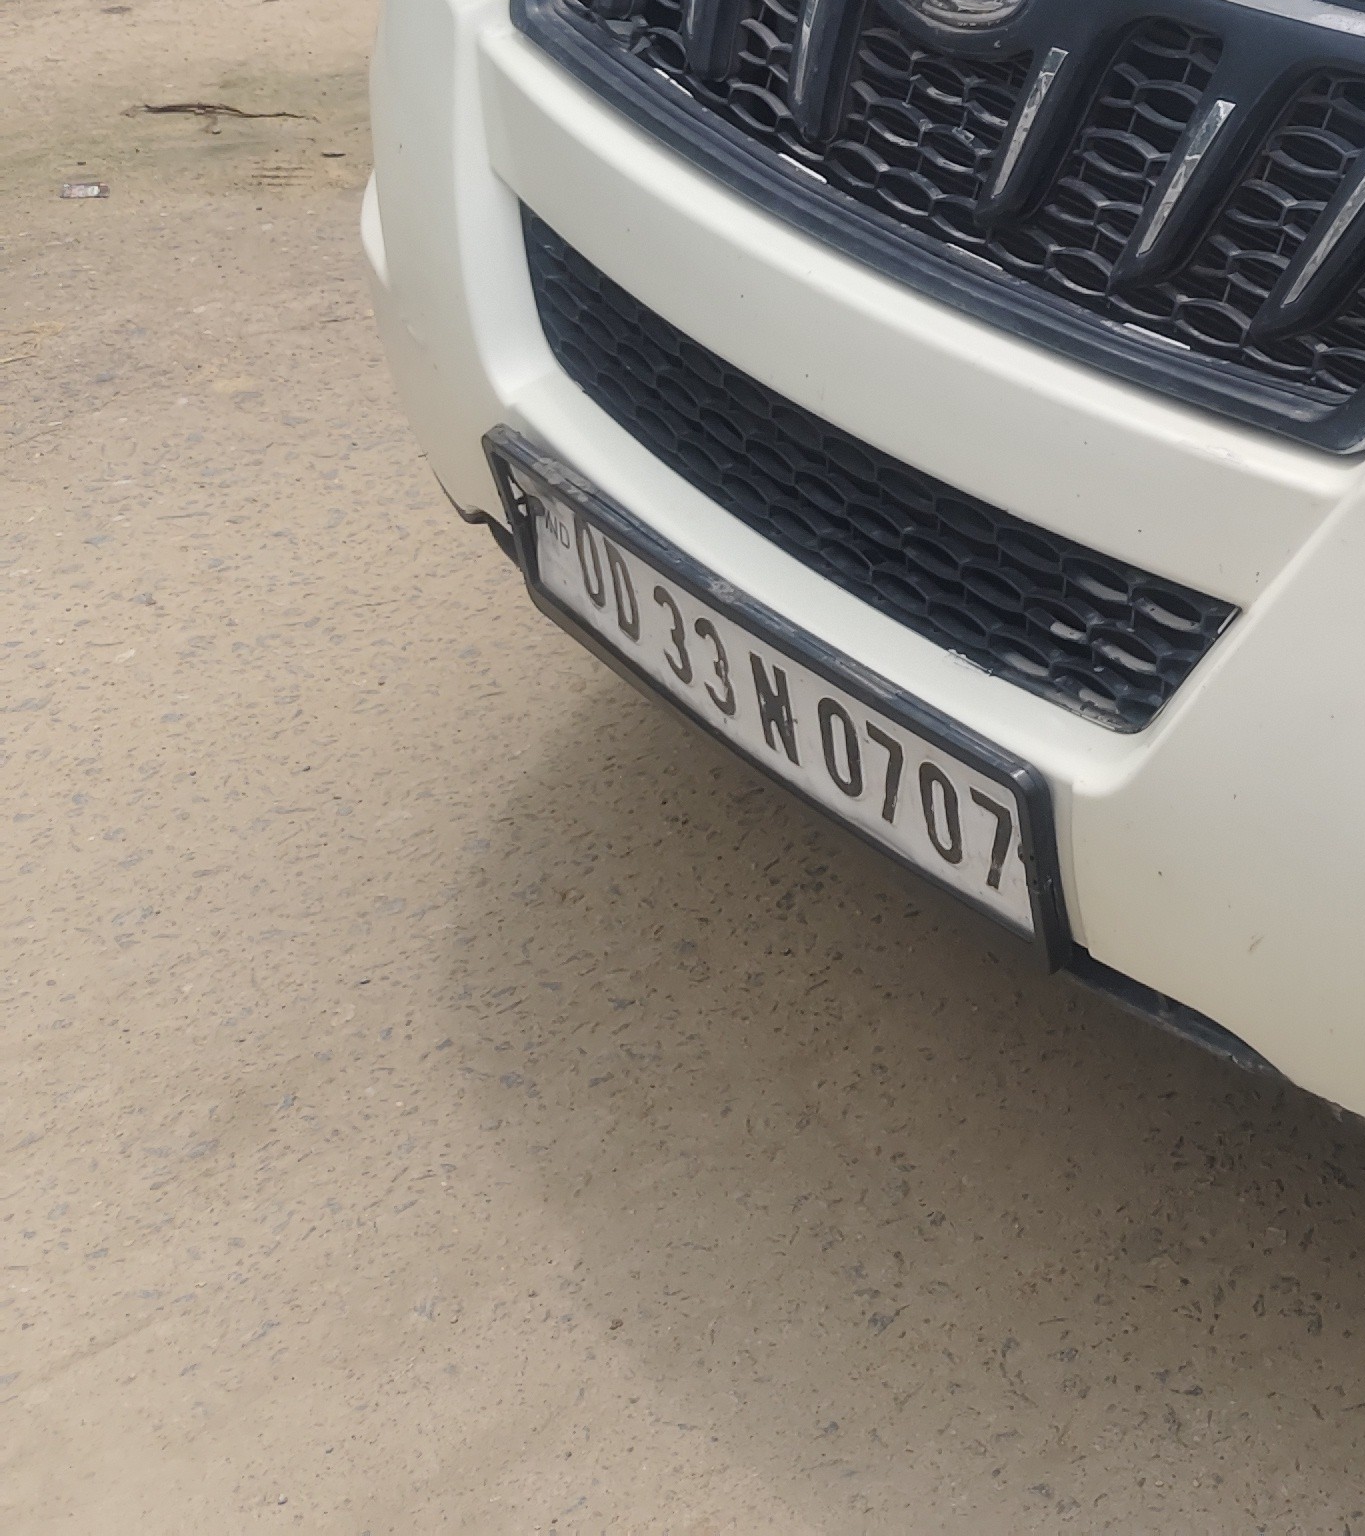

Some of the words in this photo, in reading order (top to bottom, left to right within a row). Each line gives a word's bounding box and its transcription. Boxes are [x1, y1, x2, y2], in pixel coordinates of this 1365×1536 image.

[653, 585, 737, 717] 33
[749, 652, 802, 766] N
[817, 697, 1012, 889] 0707
